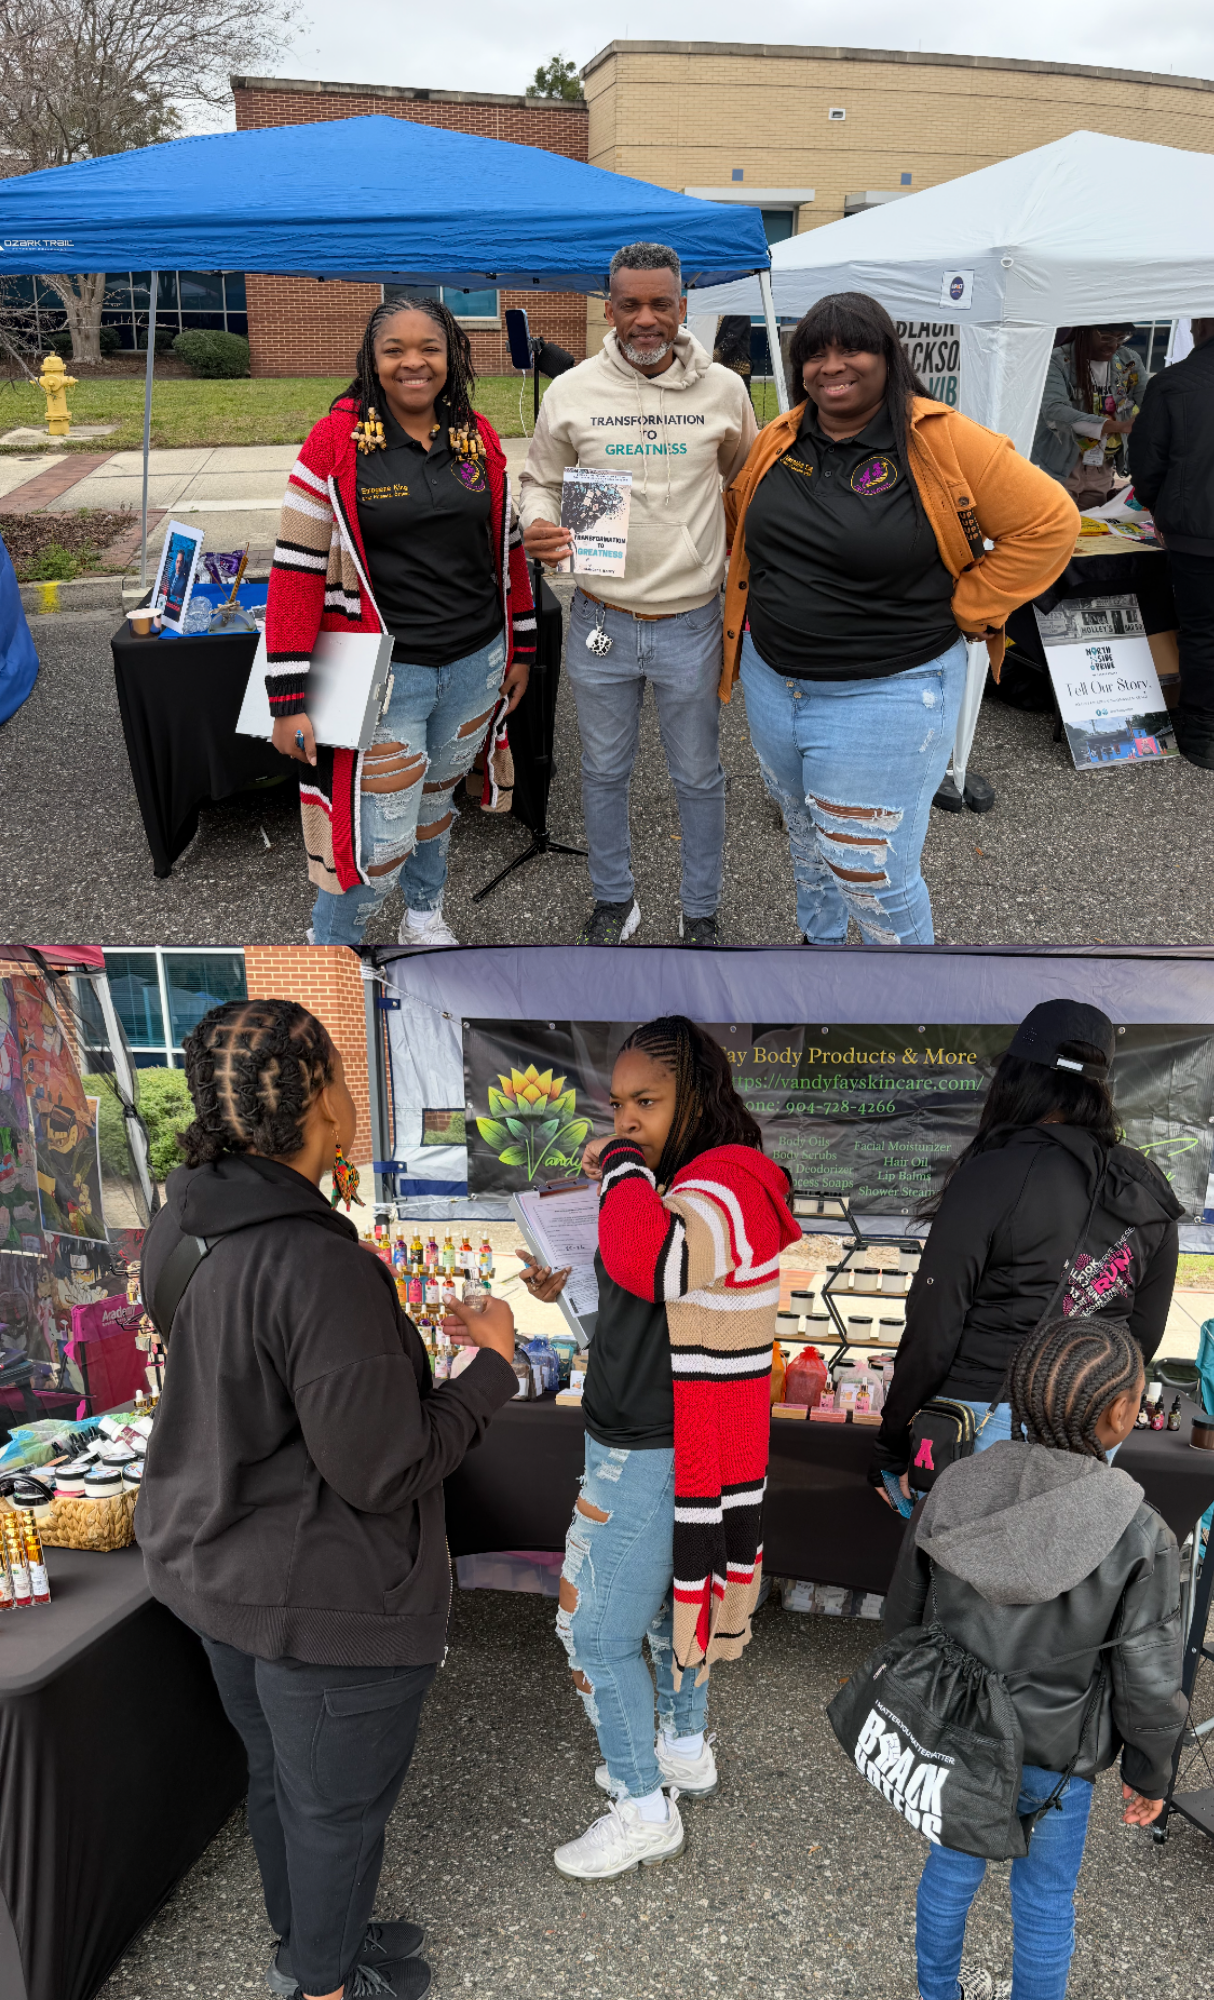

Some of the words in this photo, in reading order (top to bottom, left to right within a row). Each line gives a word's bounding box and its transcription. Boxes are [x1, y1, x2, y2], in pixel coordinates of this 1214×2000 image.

[4, 239, 42, 247] OZARK
[42, 239, 75, 247] TRAIL
[591, 415, 705, 426] TRANSFORMATION
[639, 430, 657, 440] TO
[605, 443, 687, 456] GREATNESS
[578, 548, 623, 559] GREATNESS
[1065, 681, 1088, 697] Tell
[1091, 680, 1113, 695] Our
[752, 1046, 803, 1068] Body
[807, 1047, 896, 1064] Products
[902, 1047, 919, 1065] &
[923, 1048, 977, 1065] More
[731, 1073, 984, 1093] ttps://vandyfayskincare.com/
[744, 1100, 780, 1112] one:
[785, 1099, 896, 1115] 904-728-4266
[778, 1136, 805, 1148] Body
[808, 1137, 830, 1147] Oils
[854, 1141, 885, 1151] Facial
[888, 1141, 952, 1152] Moisturizer
[525, 1117, 594, 1182] Vandy
[772, 1149, 799, 1161] Body
[802, 1150, 837, 1160] Scrubs
[883, 1156, 909, 1167] Hair
[911, 1157, 928, 1167] Oil
[796, 1164, 854, 1175] Deodorizer
[877, 1171, 896, 1182] Lip
[898, 1171, 931, 1182] Balms
[822, 1178, 854, 1190] Soaps
[858, 1185, 899, 1197] Shower
[901, 1186, 940, 1198] Steam
[1093, 1246, 1134, 1295] RUN!
[914, 1438, 934, 1471] A
